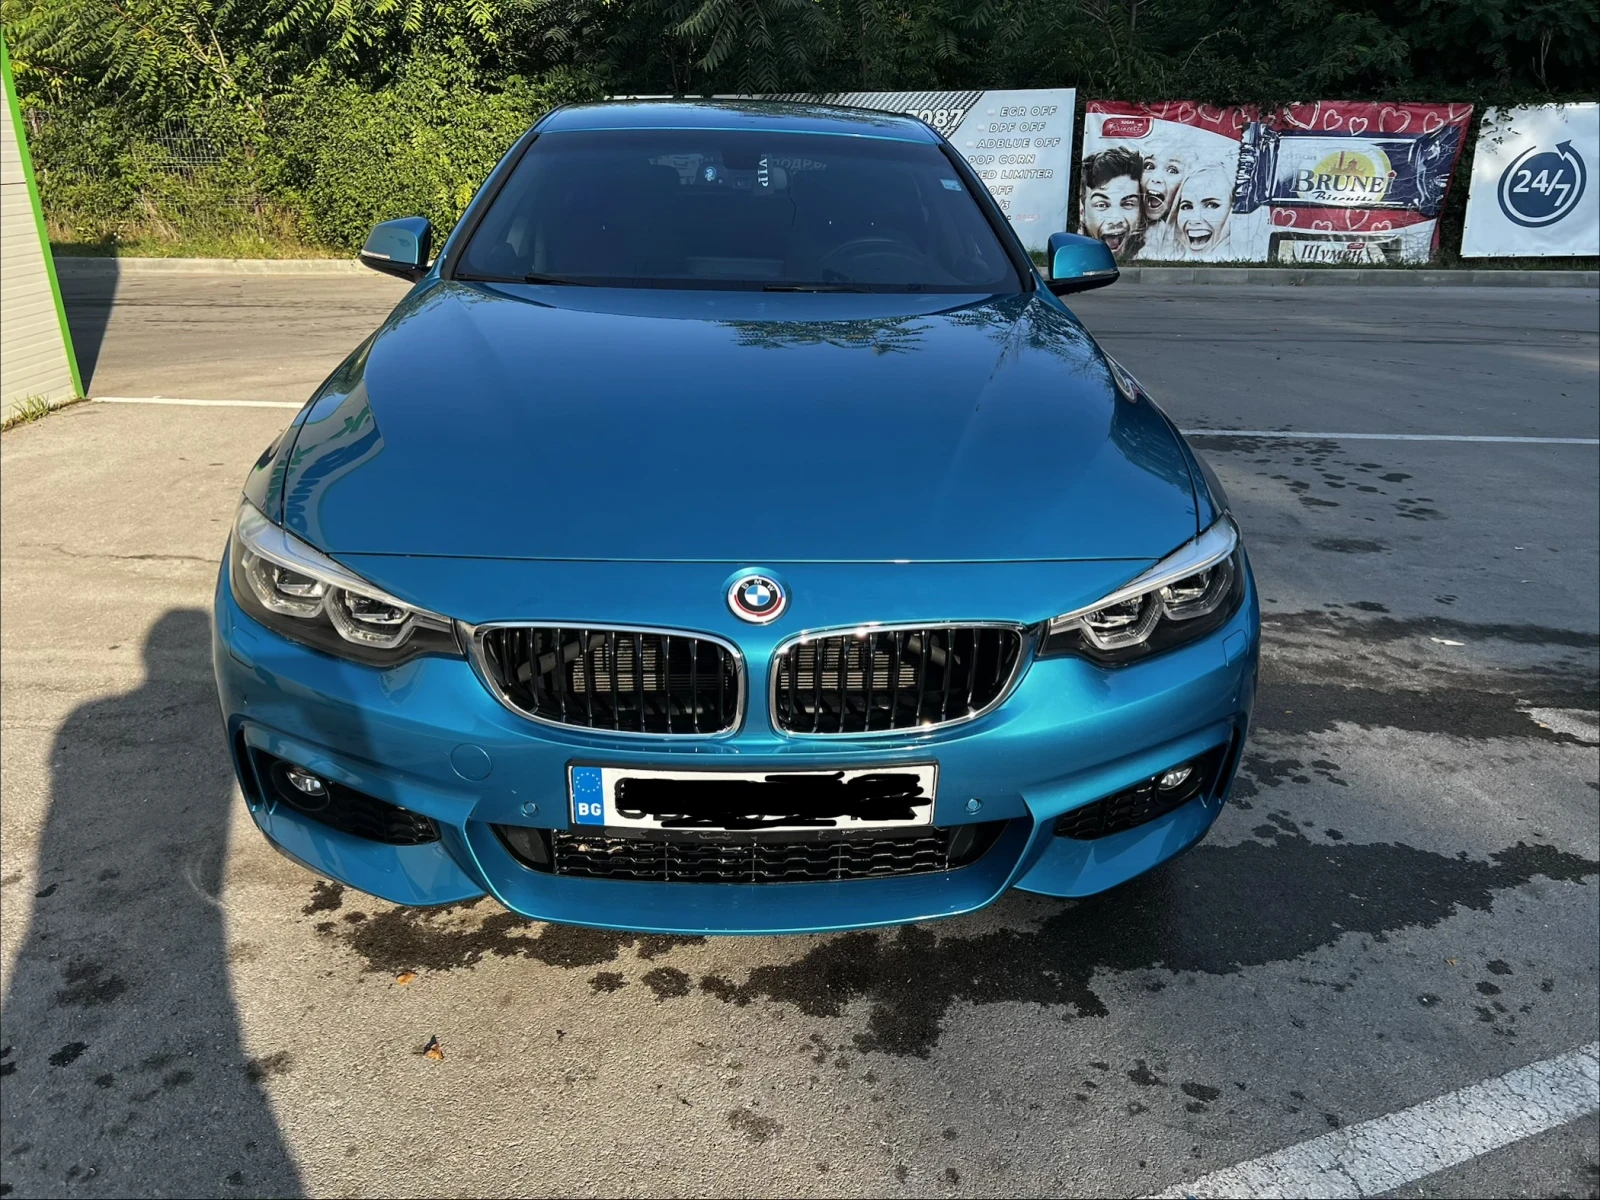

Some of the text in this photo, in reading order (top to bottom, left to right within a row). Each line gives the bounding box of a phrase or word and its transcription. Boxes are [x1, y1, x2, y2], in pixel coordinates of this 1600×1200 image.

[1000, 105, 1058, 117] EGR OFF
[989, 121, 1046, 133] DPF OFF
[976, 137, 1061, 149] ADBLUE OFF
[968, 154, 1036, 165] POP CORN
[757, 158, 769, 187] VIP
[1001, 169, 1054, 180] LIMITER
[988, 185, 1014, 195] OFF
[1512, 169, 1571, 206] 24/7
[741, 579, 776, 592] BMW
[578, 802, 601, 816] BG
